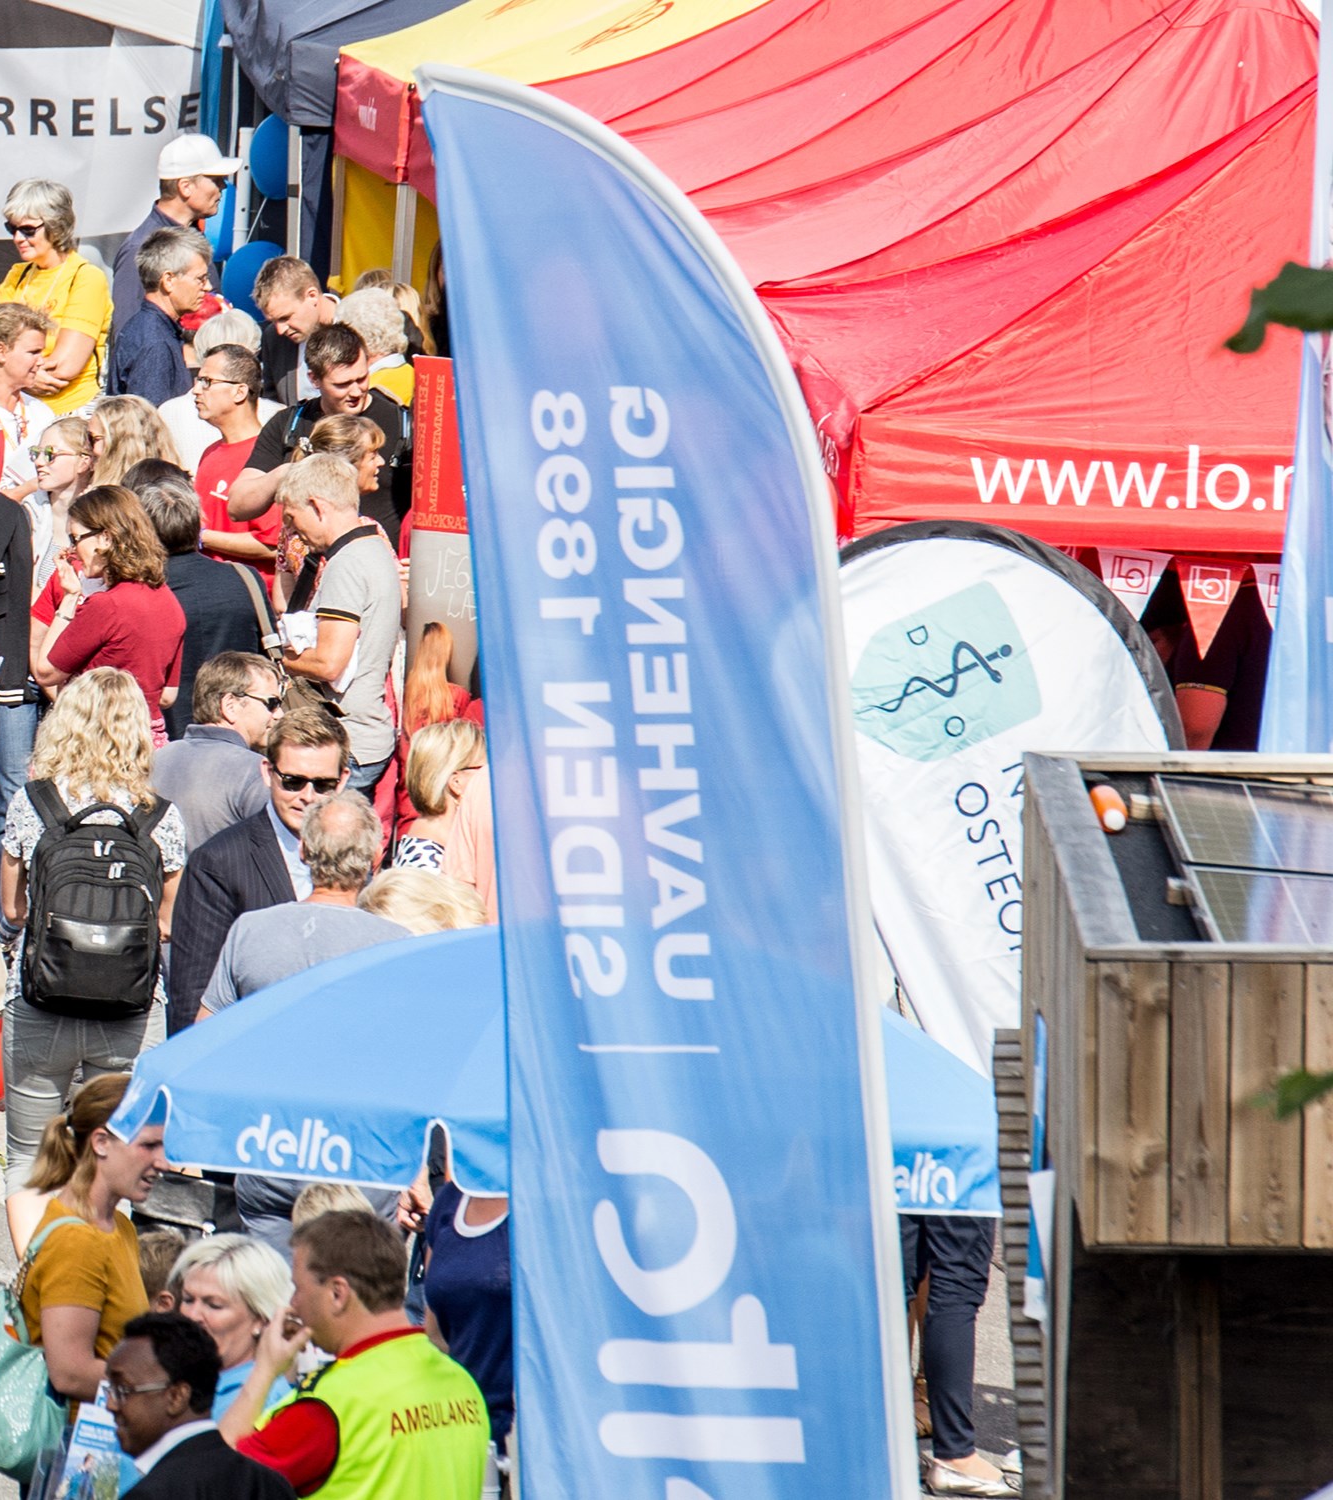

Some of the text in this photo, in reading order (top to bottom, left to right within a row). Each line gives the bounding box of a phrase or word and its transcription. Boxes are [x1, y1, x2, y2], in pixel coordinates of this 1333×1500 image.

[429, 374, 446, 512] MEDBESTEMMELSE
[426, 547, 470, 597] JEG
[955, 782, 1023, 952] OSTEO
[236, 1114, 352, 1173] delta
[391, 1398, 482, 1437] AMBULANSE
